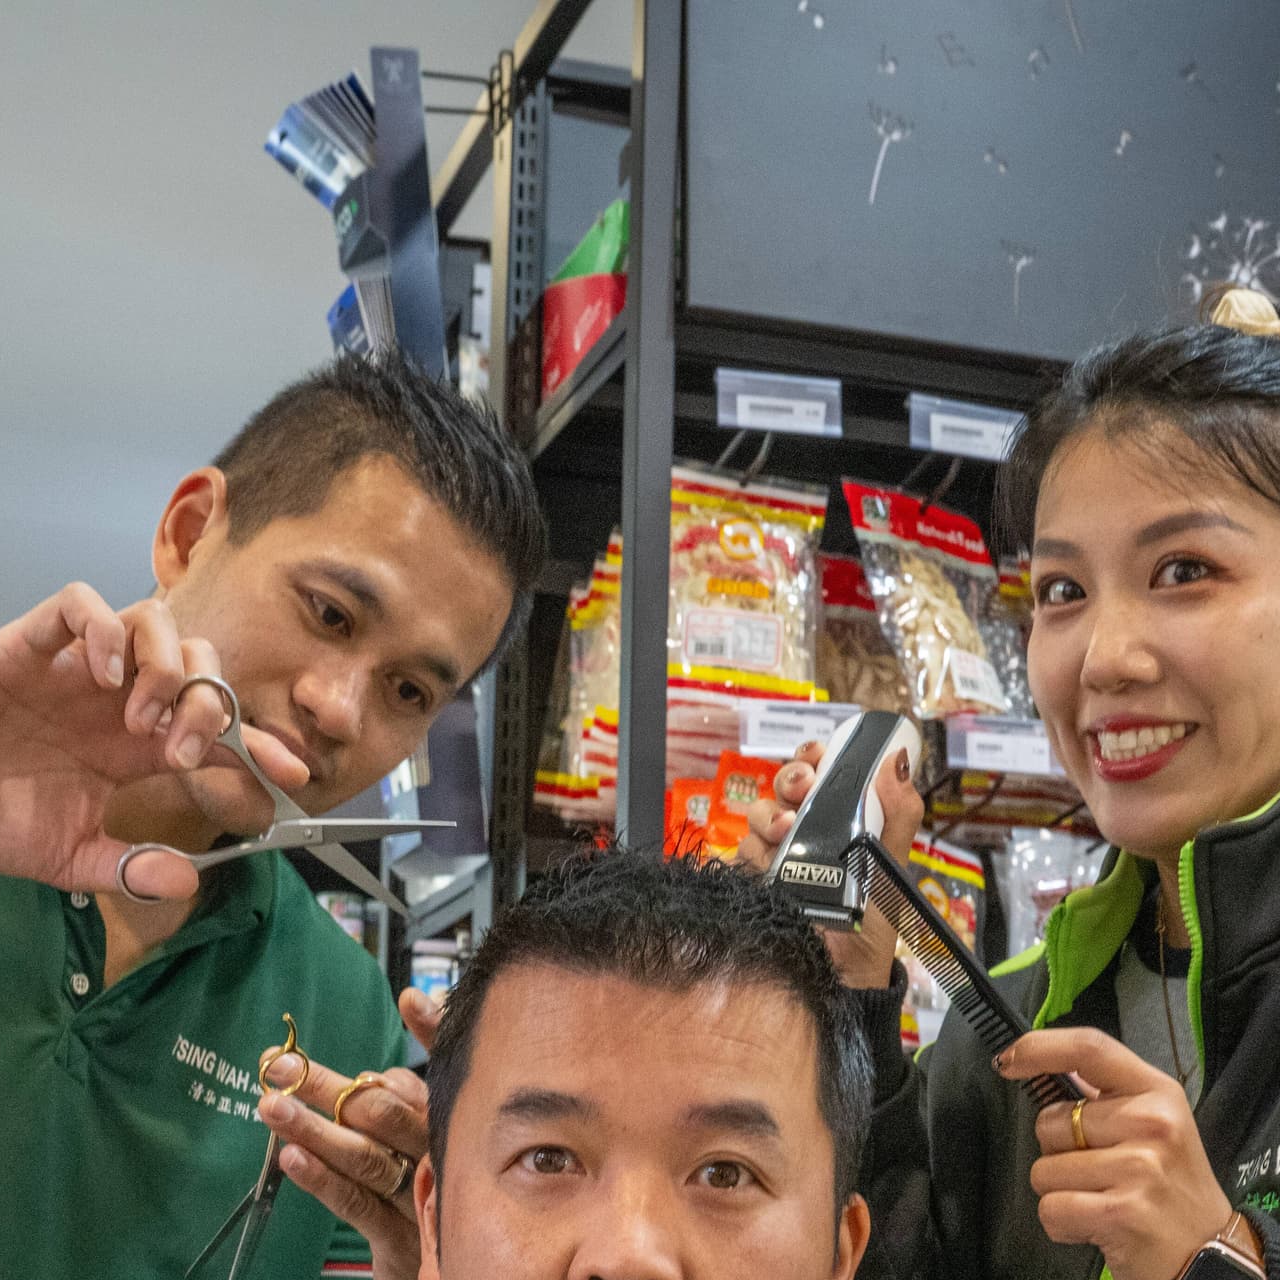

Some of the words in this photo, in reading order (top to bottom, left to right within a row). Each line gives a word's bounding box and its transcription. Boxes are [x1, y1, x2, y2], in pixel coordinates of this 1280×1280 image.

[784, 865, 840, 884] WAHL
[172, 1034, 217, 1074] TSING
[216, 1058, 250, 1093] WAH
[188, 1080, 263, 1121] 清华亚洲
[1236, 1148, 1271, 1188] TNG
